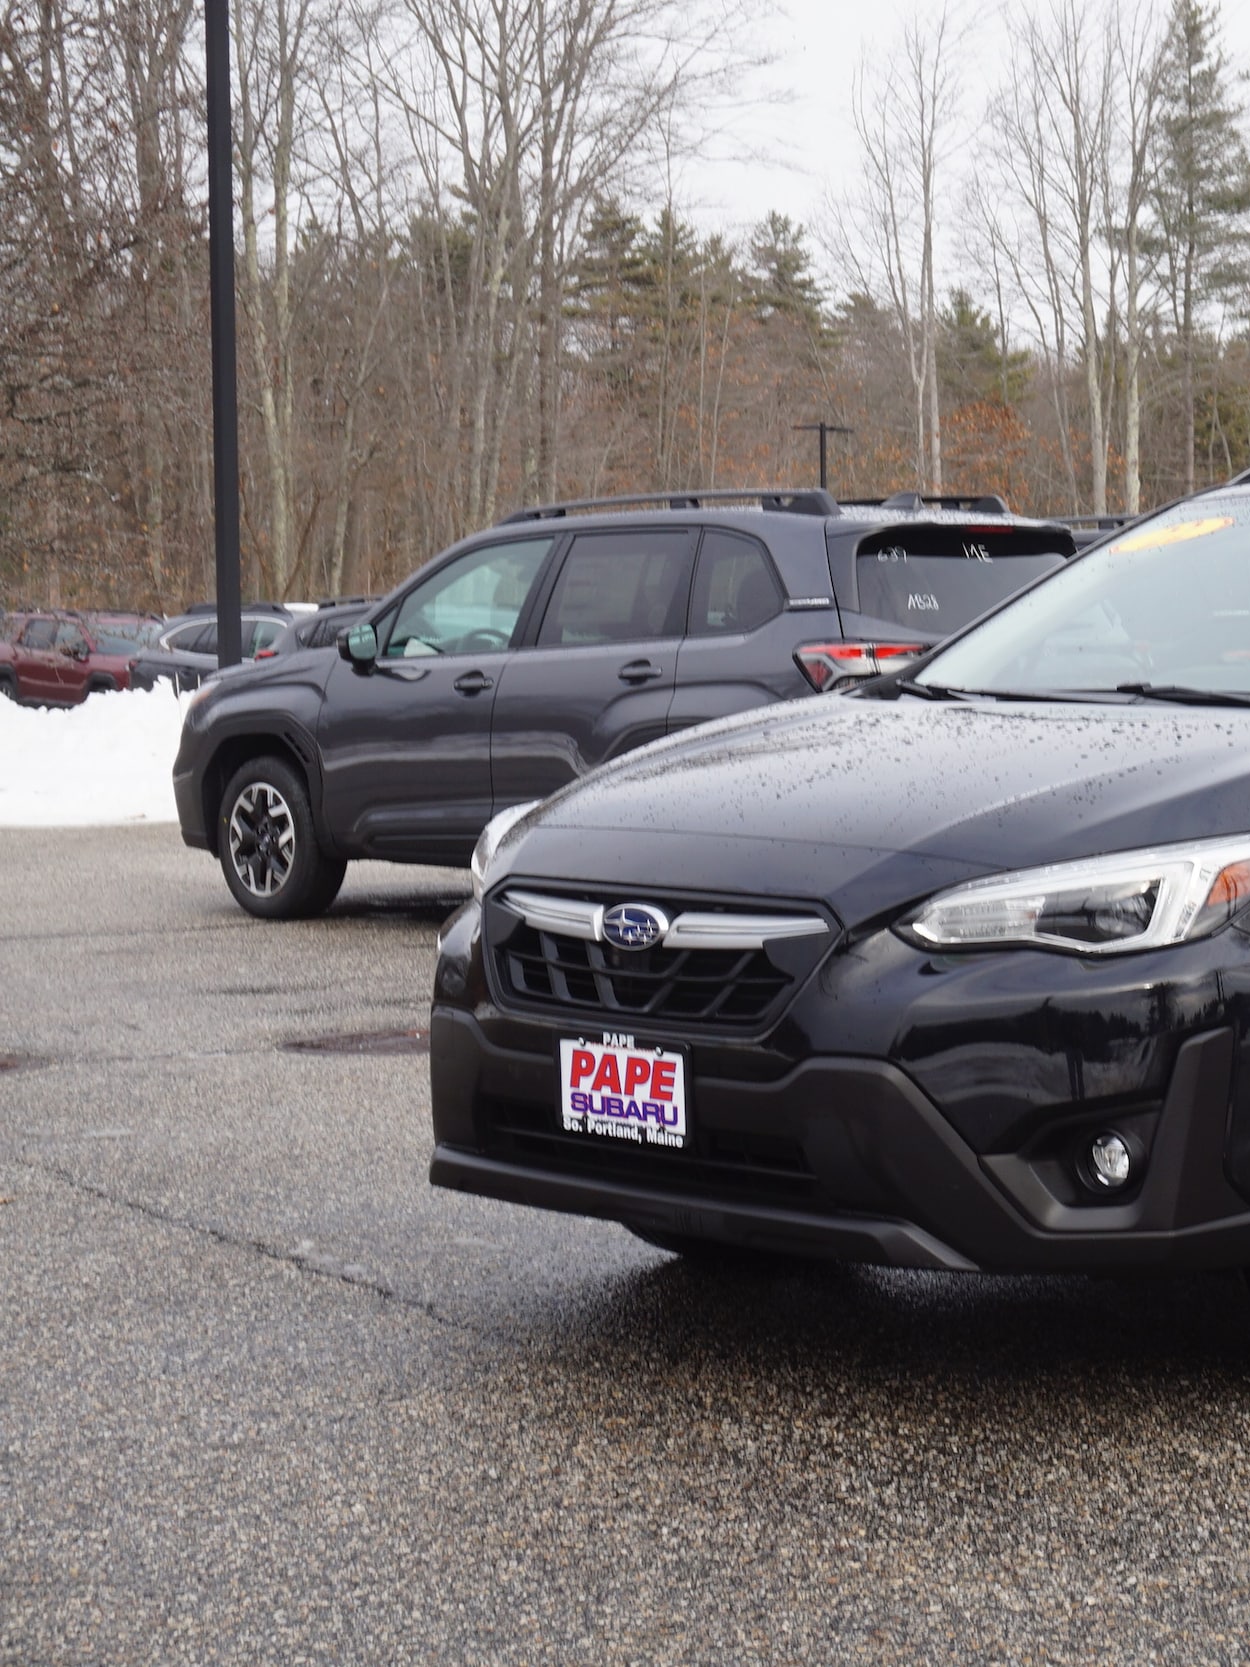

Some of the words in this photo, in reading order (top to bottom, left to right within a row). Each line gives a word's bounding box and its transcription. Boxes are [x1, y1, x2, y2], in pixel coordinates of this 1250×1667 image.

[602, 1031, 635, 1049] PAPE
[570, 1049, 677, 1101] PAPE
[570, 1092, 678, 1126] SUBARU
[563, 1117, 583, 1132] So.
[587, 1117, 642, 1144] Portland,
[646, 1127, 684, 1149] Maine
